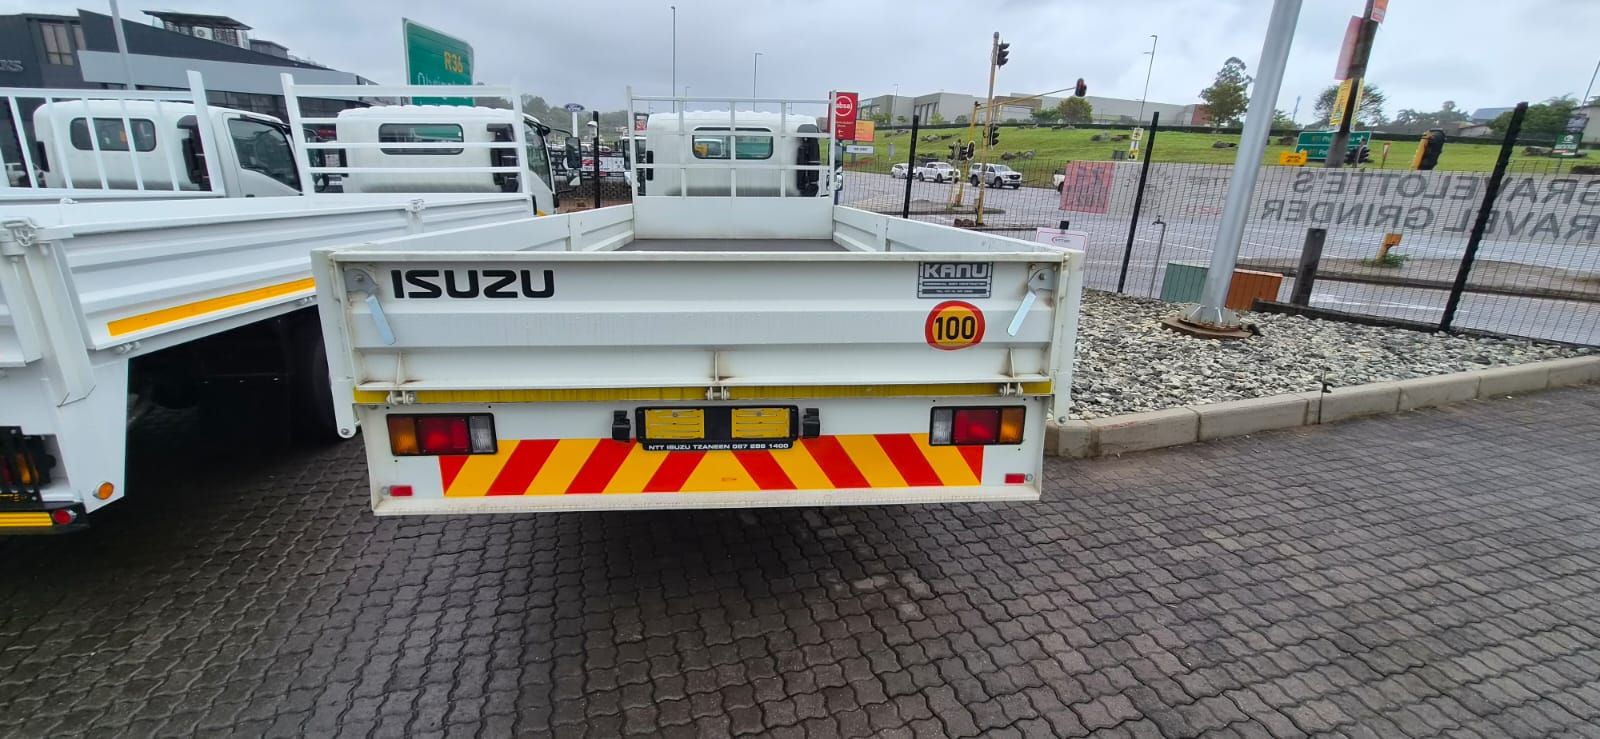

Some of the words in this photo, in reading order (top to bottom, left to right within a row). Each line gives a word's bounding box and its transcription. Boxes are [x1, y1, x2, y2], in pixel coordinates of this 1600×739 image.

[444, 51, 464, 73] R36
[924, 263, 988, 278] KANU
[391, 270, 555, 299] ISUZU
[935, 315, 976, 341] 100
